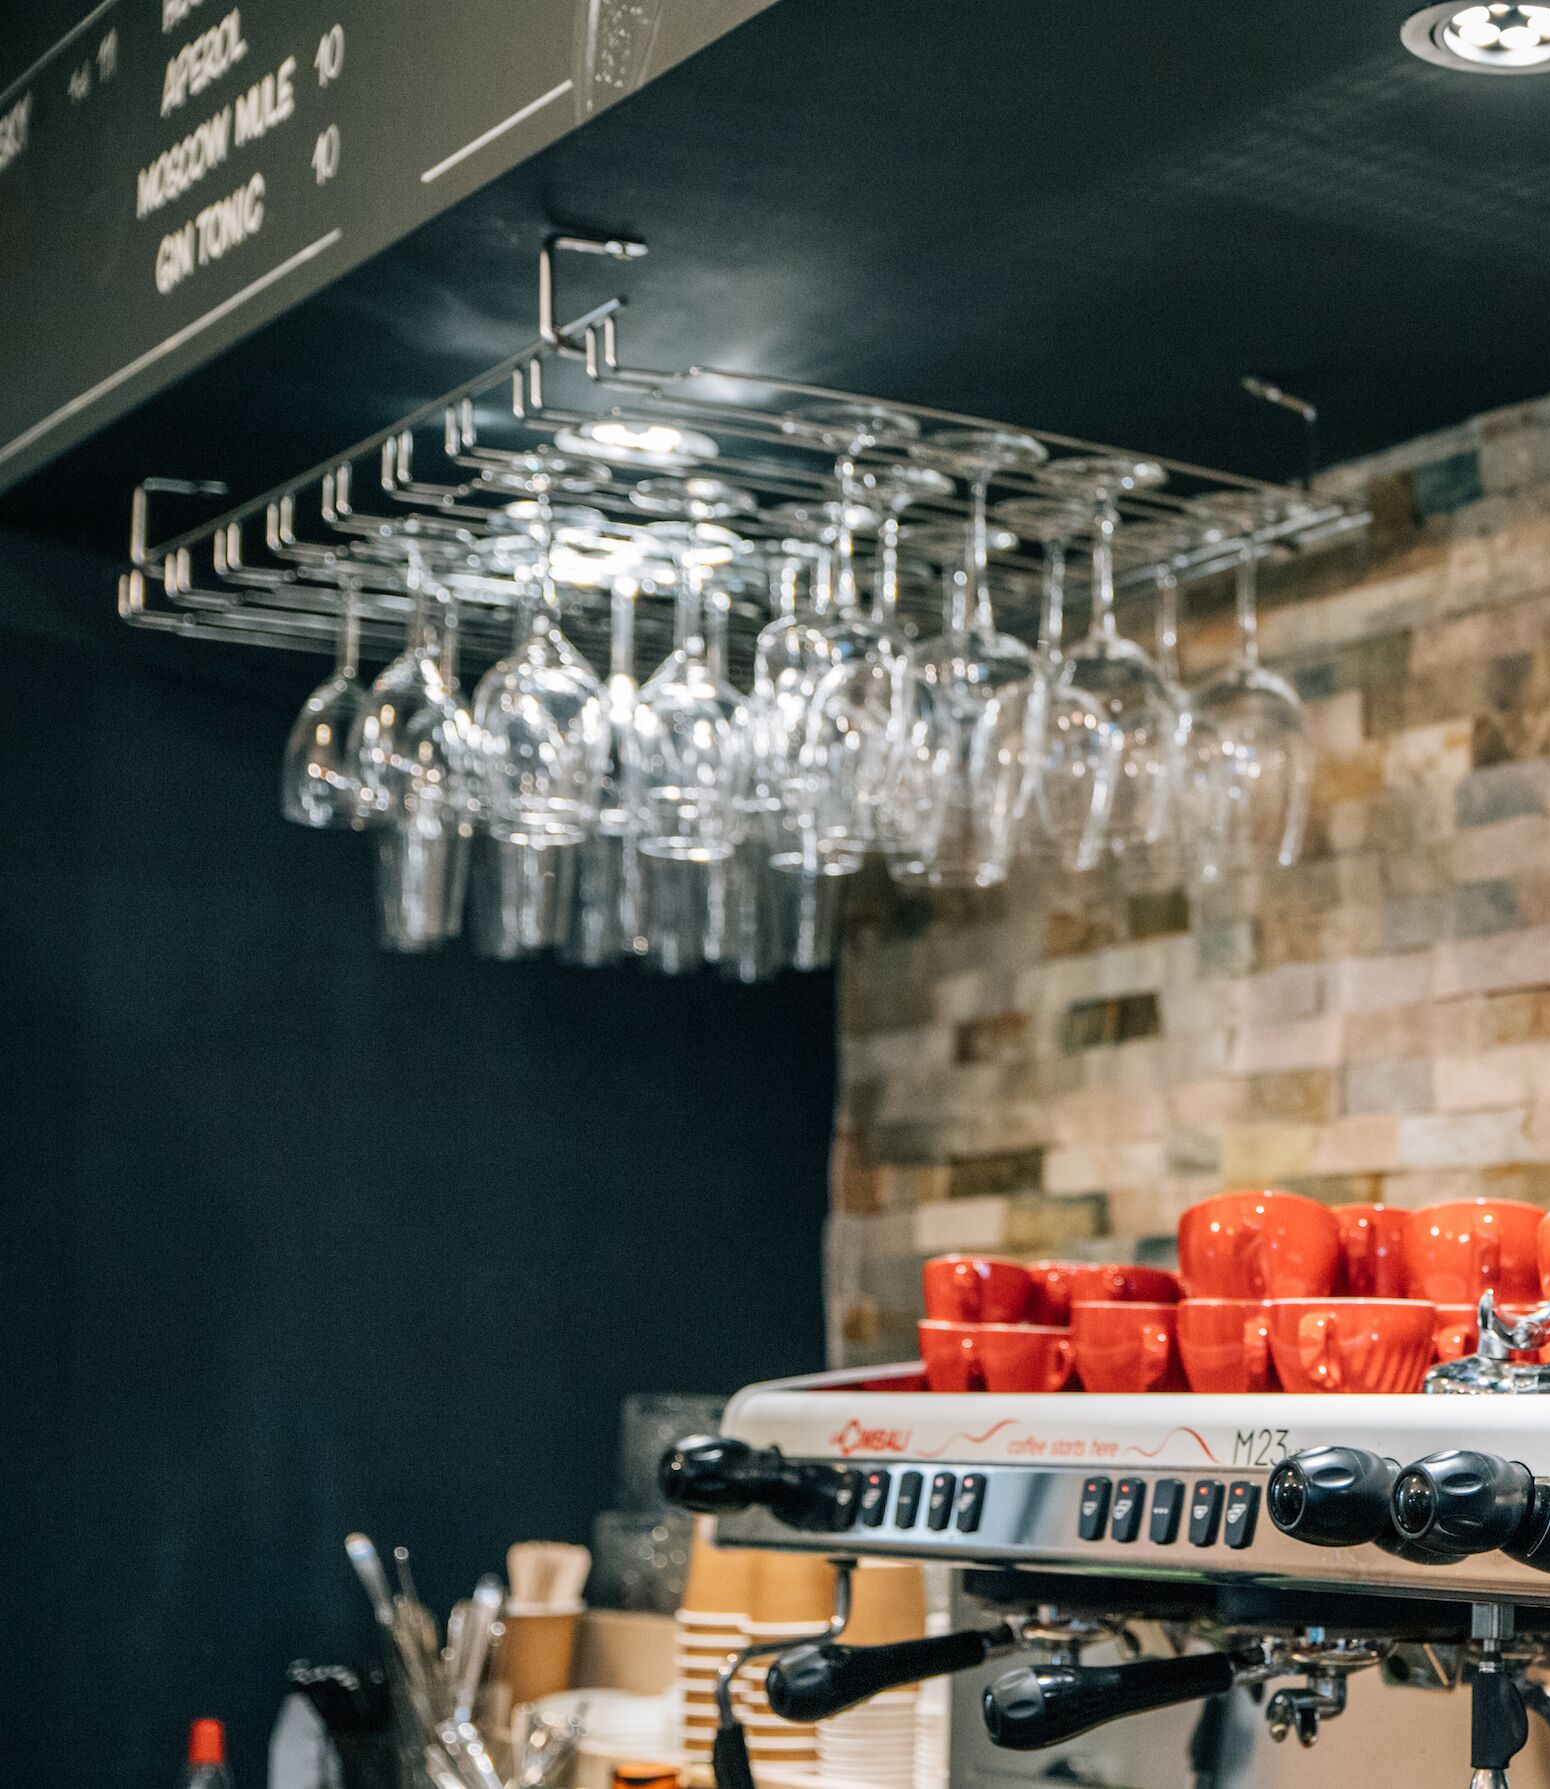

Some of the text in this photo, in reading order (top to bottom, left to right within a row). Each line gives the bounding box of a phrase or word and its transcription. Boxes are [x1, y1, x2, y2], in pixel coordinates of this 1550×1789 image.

[160, 7, 249, 118] APEROL
[136, 23, 345, 219] MOSCOW MULE 10
[155, 123, 341, 294] GIN TONIC 10
[1007, 1437, 1121, 1458] coffee starts here
[1233, 1428, 1289, 1466] M23
